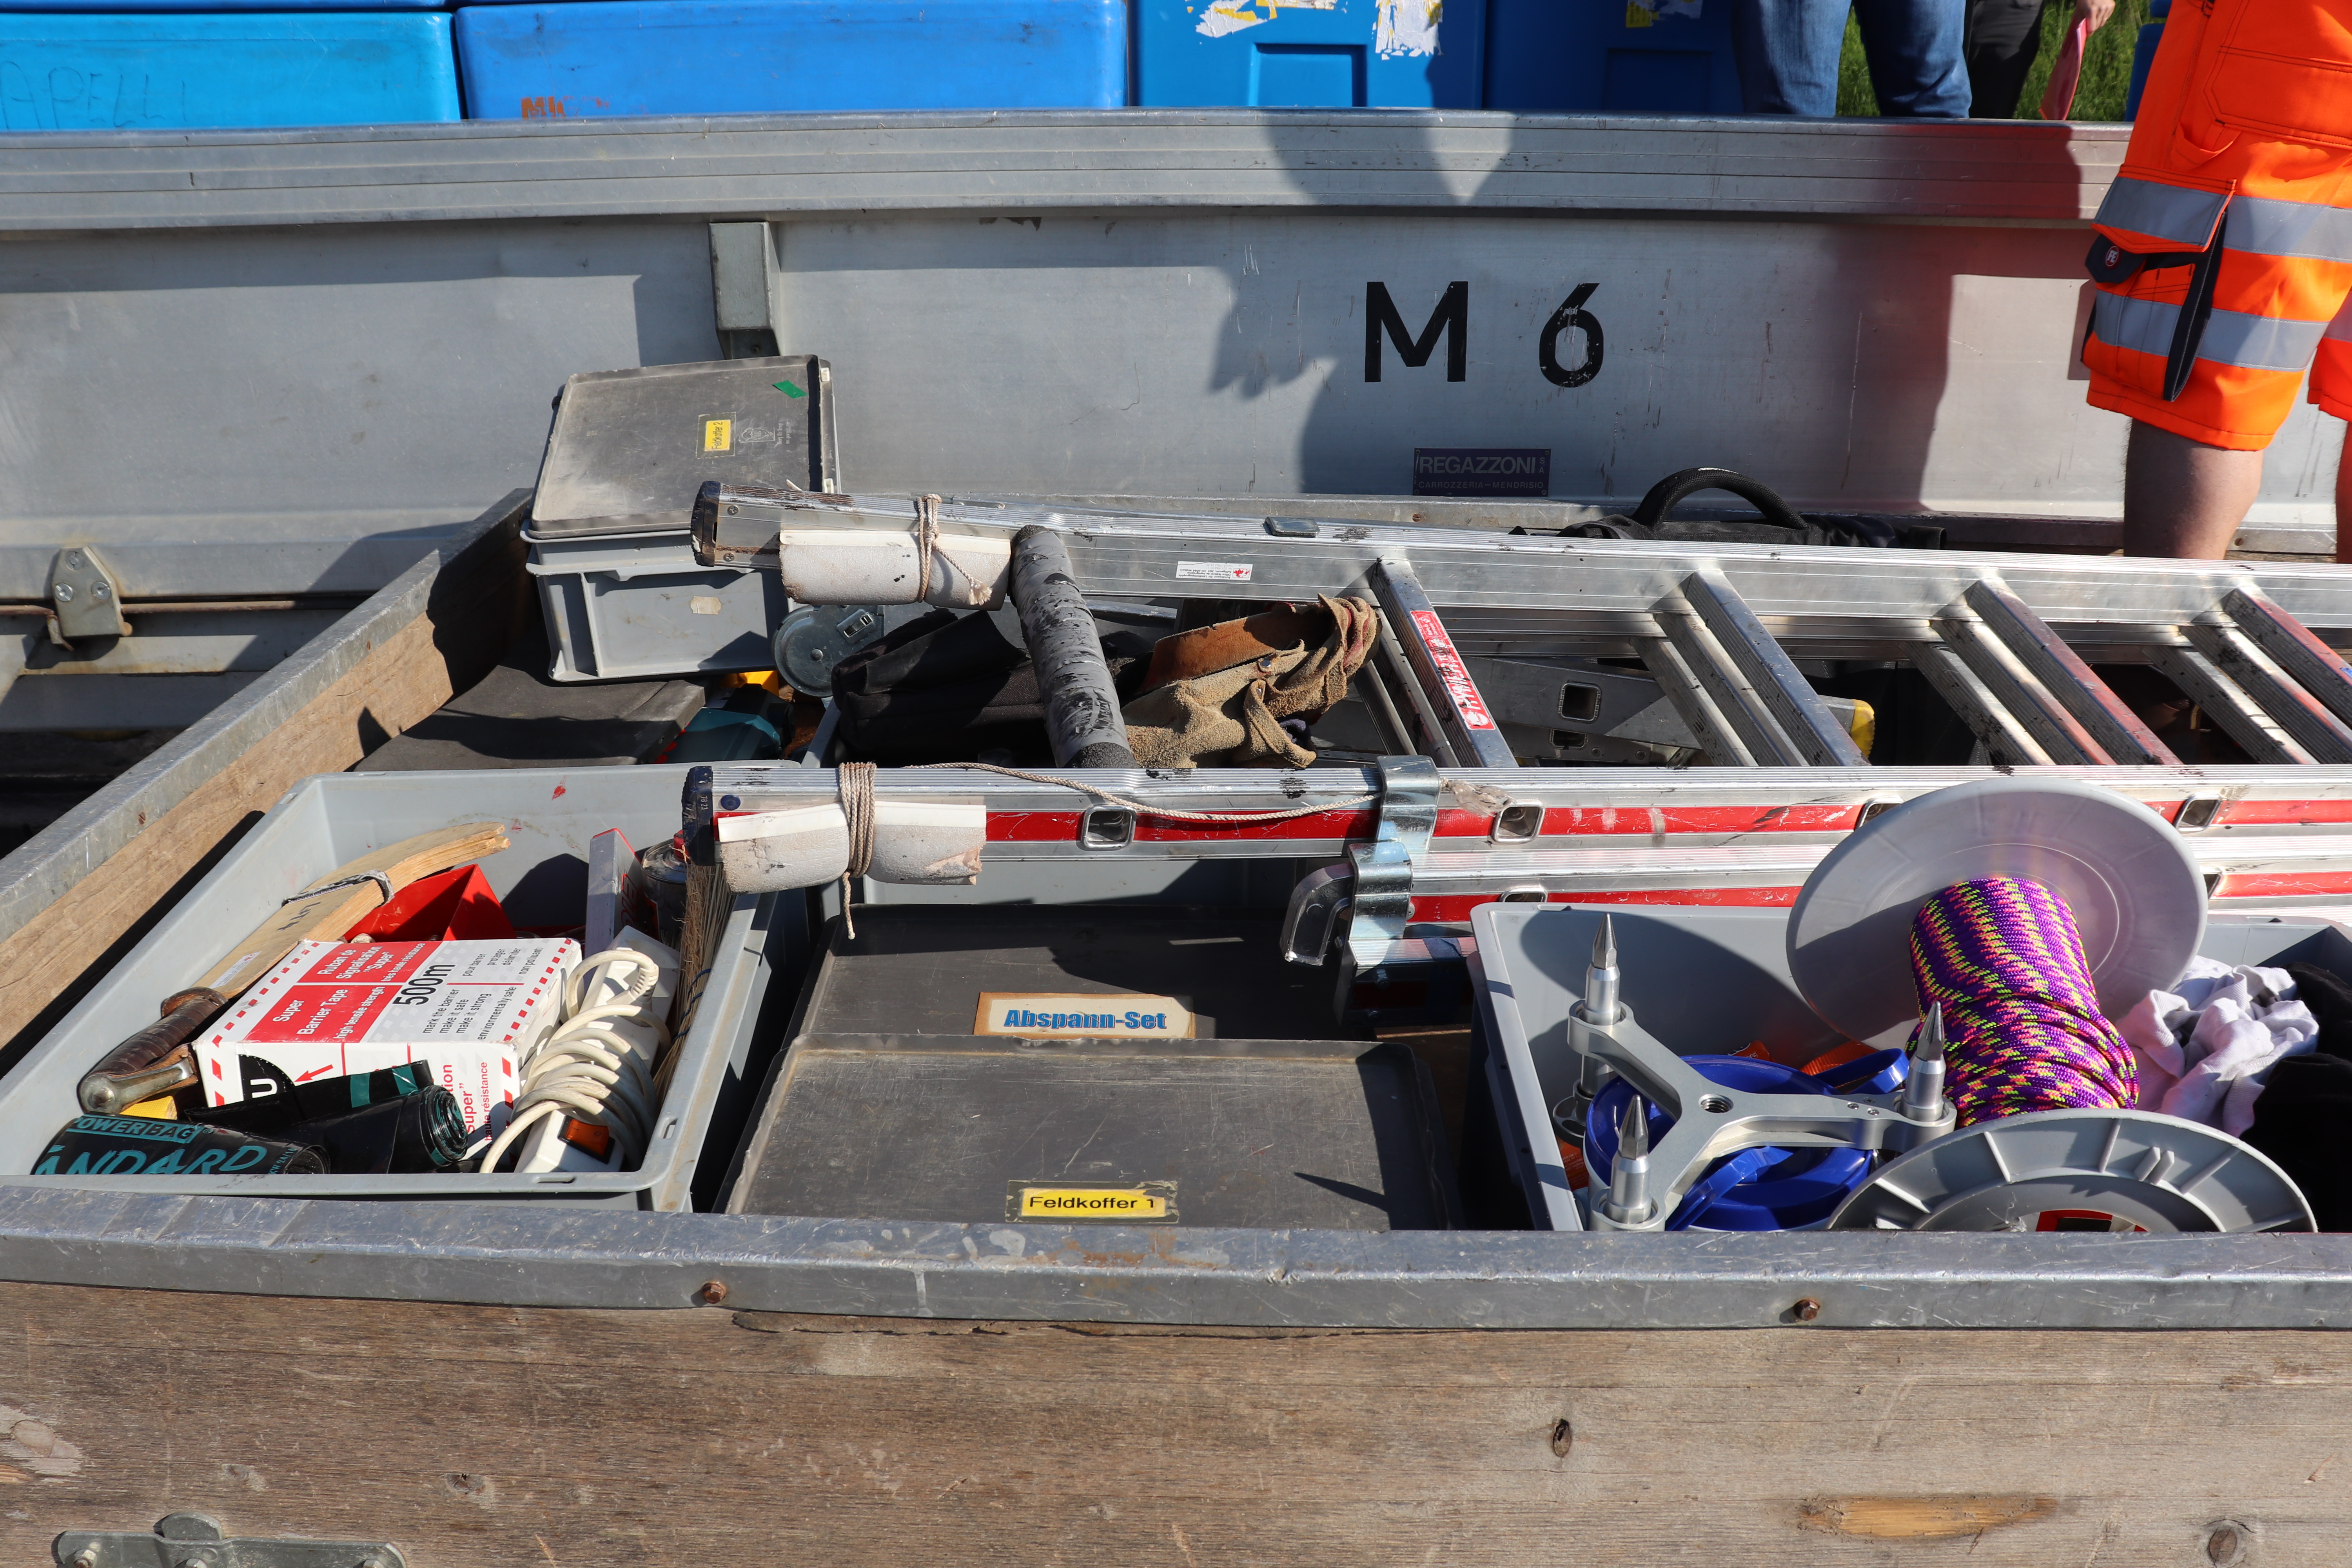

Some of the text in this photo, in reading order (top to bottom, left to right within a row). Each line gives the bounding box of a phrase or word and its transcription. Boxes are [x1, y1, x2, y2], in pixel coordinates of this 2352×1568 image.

[1365, 281, 1604, 388] M 6
[711, 426, 723, 449] Feldkoffer
[1419, 456, 1536, 475] REGAZZONI
[1439, 663, 1481, 710] HYMER
[317, 956, 349, 974] Ruban
[336, 946, 383, 979] Signalisation
[381, 943, 425, 982] très haute résistance
[462, 953, 487, 976] pour barrer
[486, 949, 506, 965] protéger
[501, 948, 522, 965] délimiter
[518, 947, 544, 975] non polluant
[272, 1000, 305, 1022] Super
[296, 989, 348, 1034] Barrier Tape
[333, 986, 385, 1039] high tensile strength
[422, 989, 460, 1033] mark the barrier
[439, 1017, 457, 1033] make
[454, 999, 469, 1011] safe
[456, 1017, 473, 1033] make
[470, 993, 492, 1011] strong
[477, 987, 517, 1040] environmentally safe
[1003, 1009, 1167, 1030] Abspann-Set
[480, 1062, 491, 1112] résistance
[483, 1115, 493, 1141] haute
[276, 1148, 298, 1163] 24/16
[1029, 1196, 1154, 1209] Feldkoffer 1
